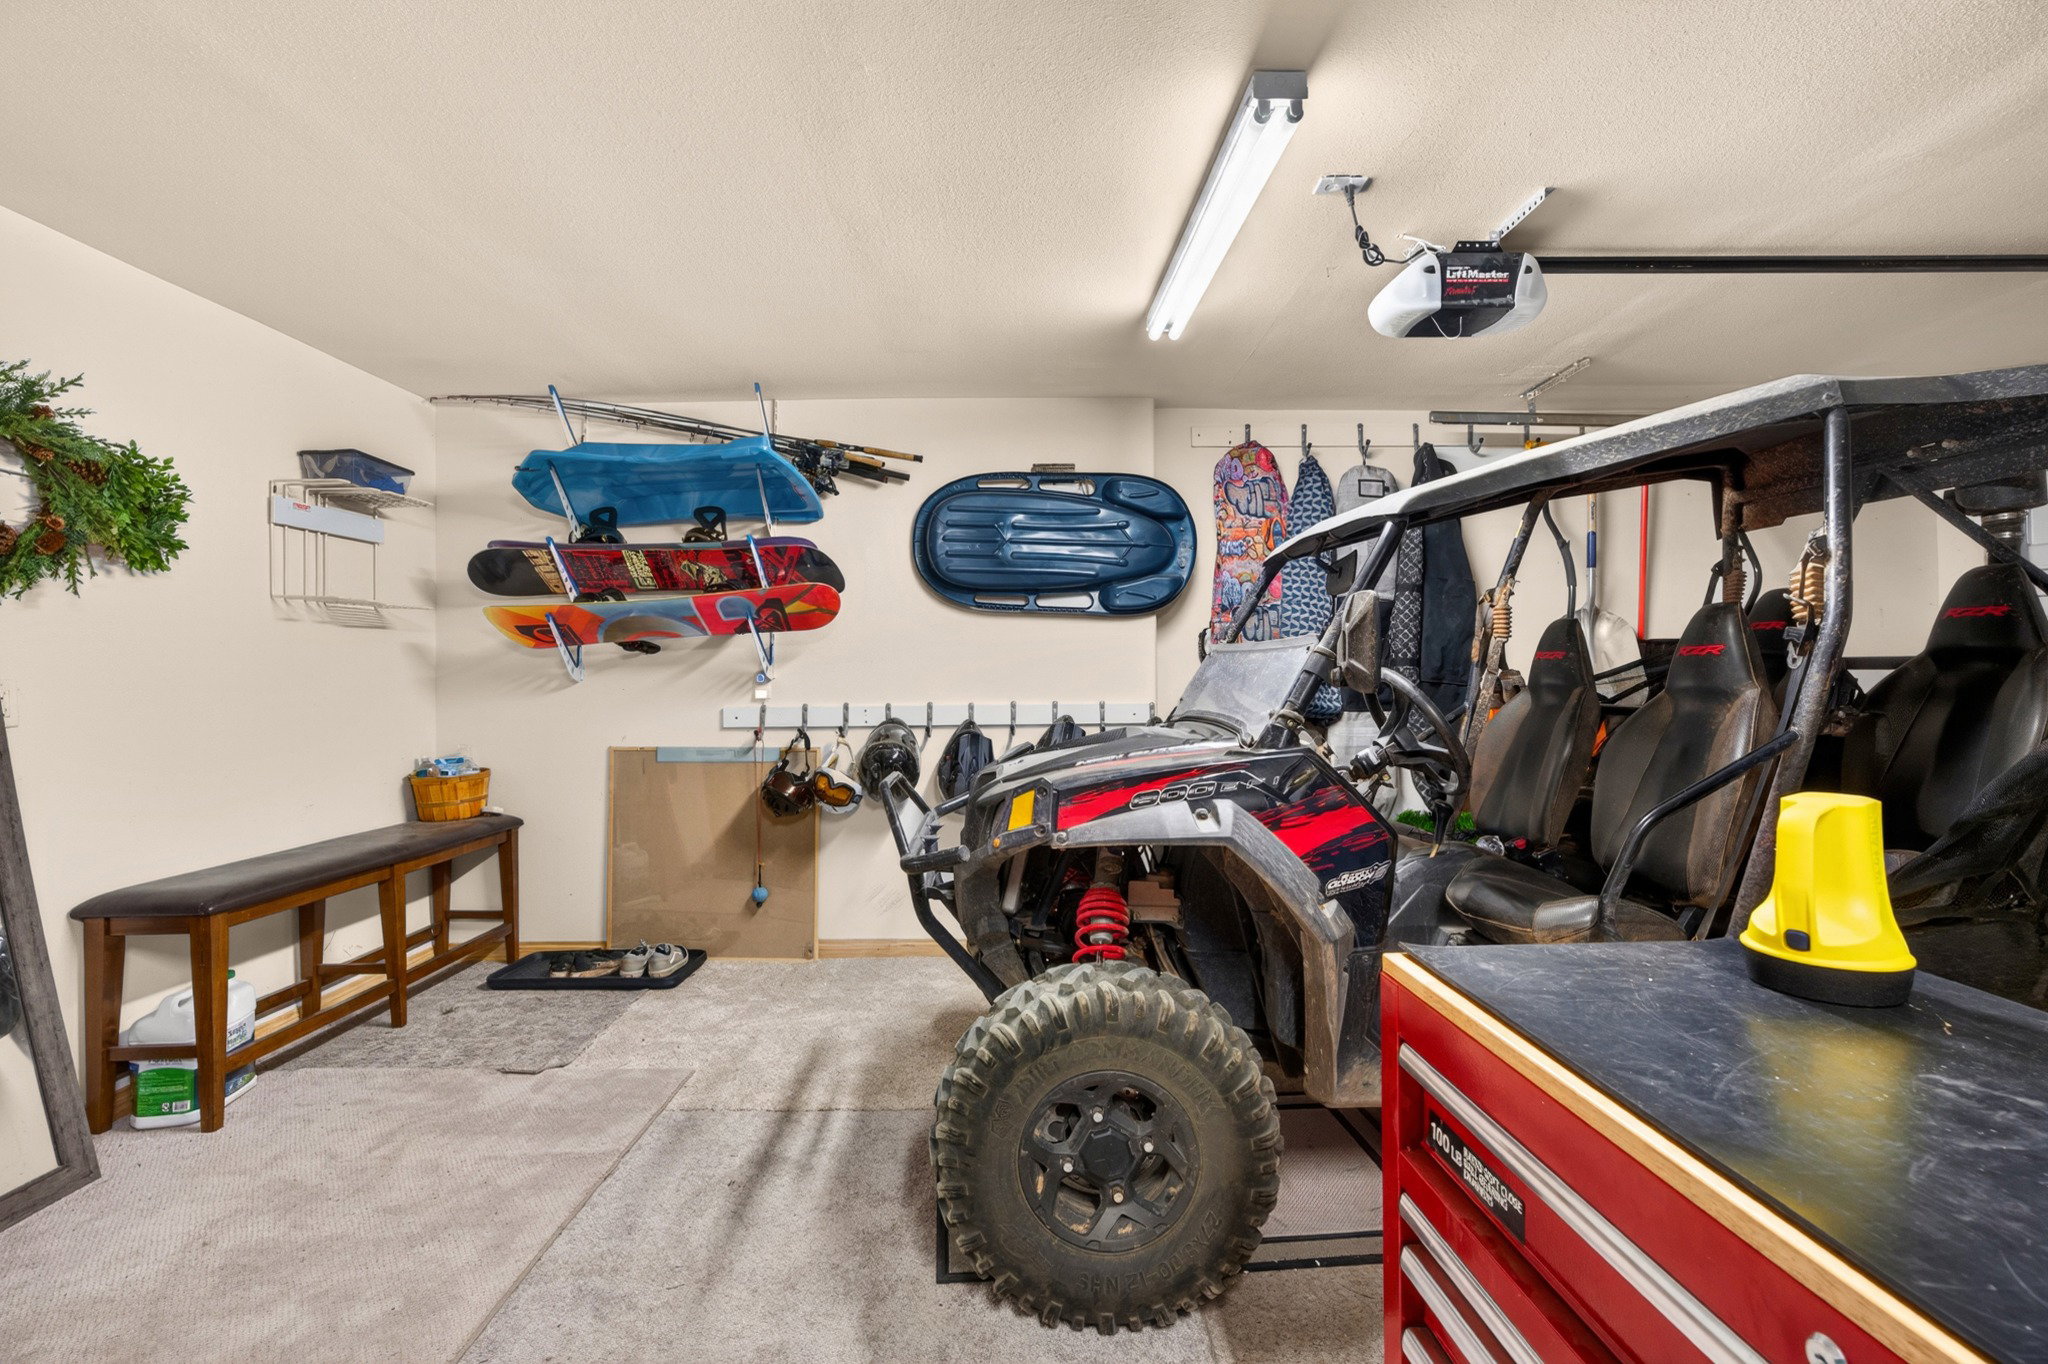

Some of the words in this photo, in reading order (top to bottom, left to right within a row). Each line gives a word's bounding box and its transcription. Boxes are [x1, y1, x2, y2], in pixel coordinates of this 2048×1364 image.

[1446, 269, 1509, 279] LiftMaster
[1942, 604, 2011, 619] RZR
[1677, 643, 1727, 656] RZR
[1430, 1121, 1450, 1154] 100
[1450, 1145, 1463, 1168] LB
[1483, 1167, 1500, 1191] SOFT
[1500, 1184, 1523, 1215] CLOSE
